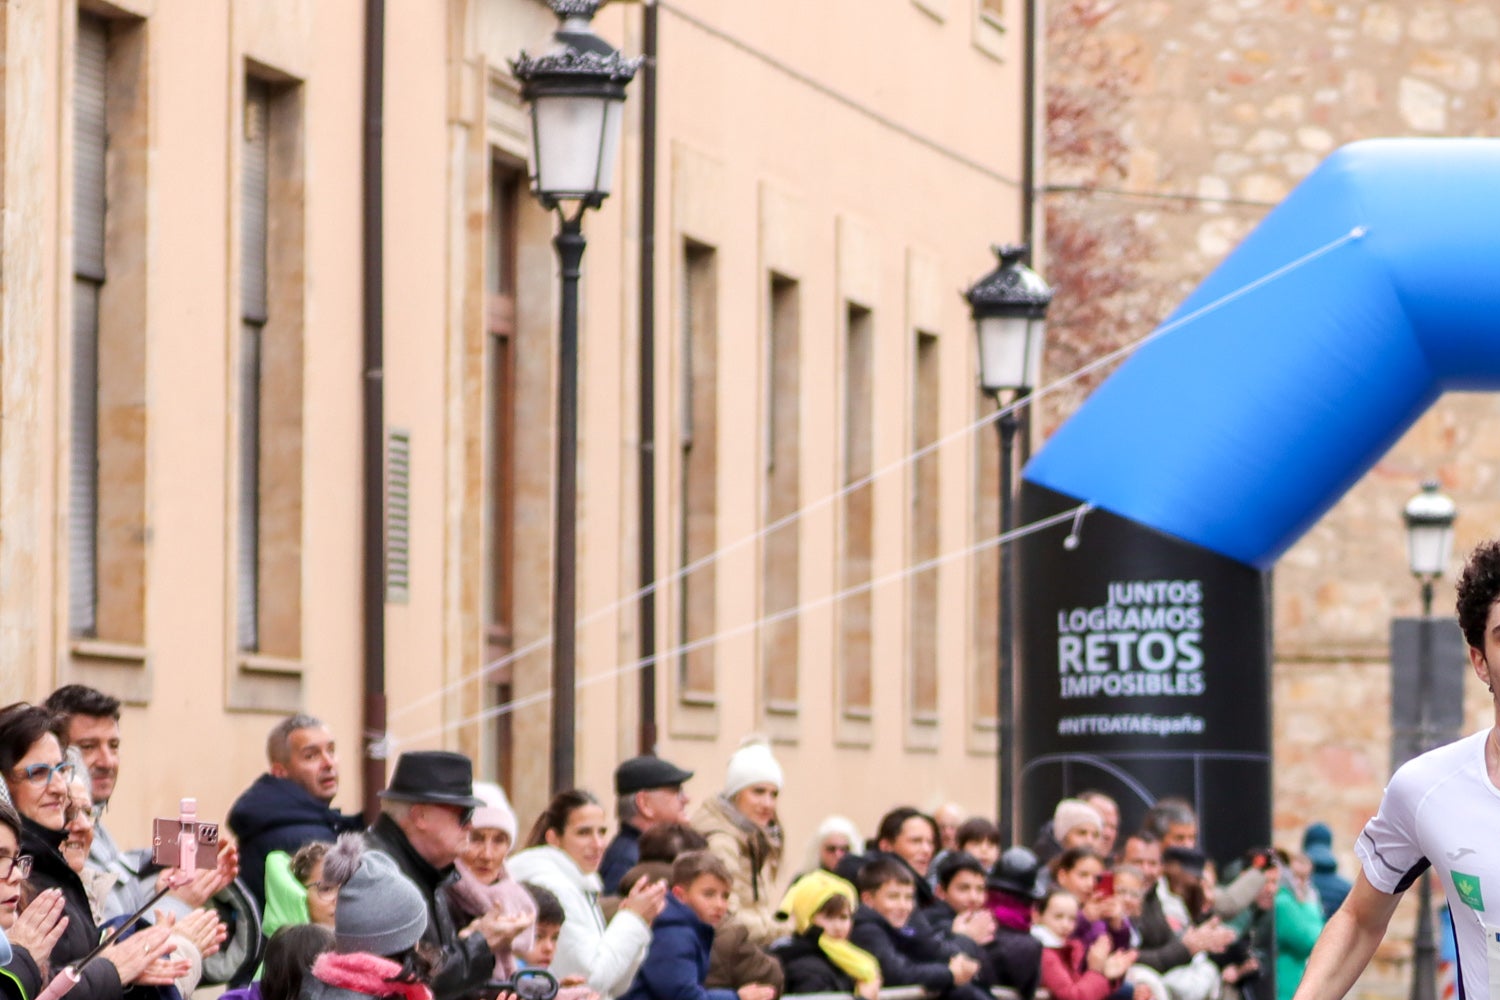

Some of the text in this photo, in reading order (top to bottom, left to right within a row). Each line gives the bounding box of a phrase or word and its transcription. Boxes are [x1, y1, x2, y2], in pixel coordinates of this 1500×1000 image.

[1106, 581, 1203, 608] JUNTOS
[1058, 606, 1203, 633] LOGRAMOS
[1058, 632, 1204, 673] RETOS
[1060, 672, 1205, 698] IMPOSIBLES
[1058, 714, 1205, 737] #NTTDATAEspaña
